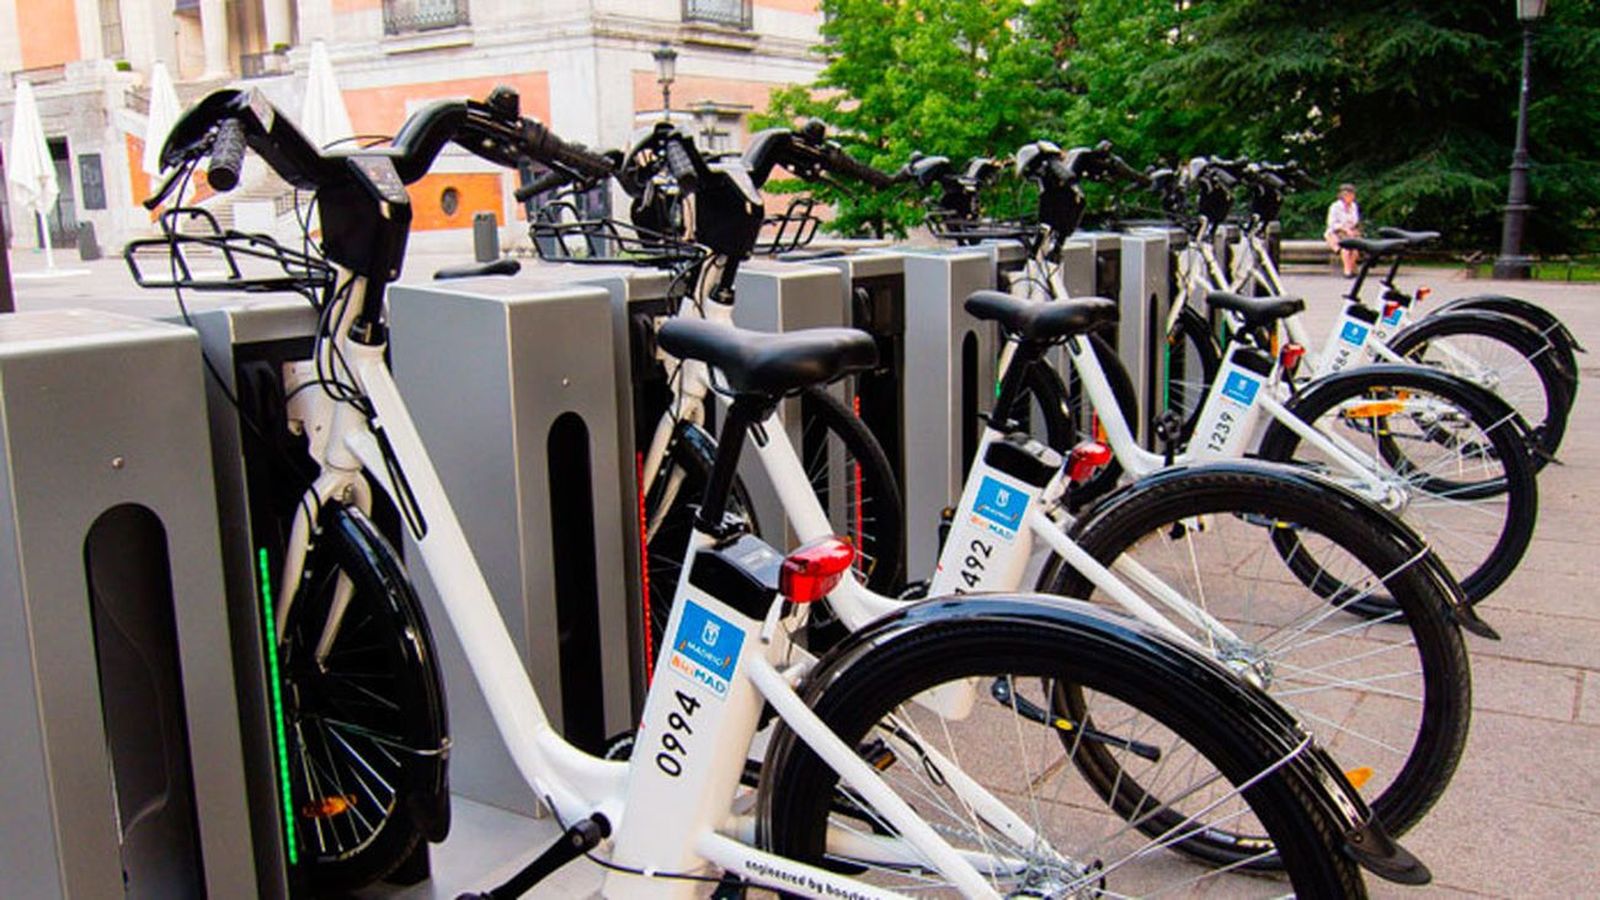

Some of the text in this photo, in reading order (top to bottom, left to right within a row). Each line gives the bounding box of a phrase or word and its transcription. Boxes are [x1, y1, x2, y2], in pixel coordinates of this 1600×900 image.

[1208, 411, 1234, 452] 1239
[656, 689, 701, 777] 0994
[745, 859, 806, 886] engineered
[808, 877, 823, 893] by
